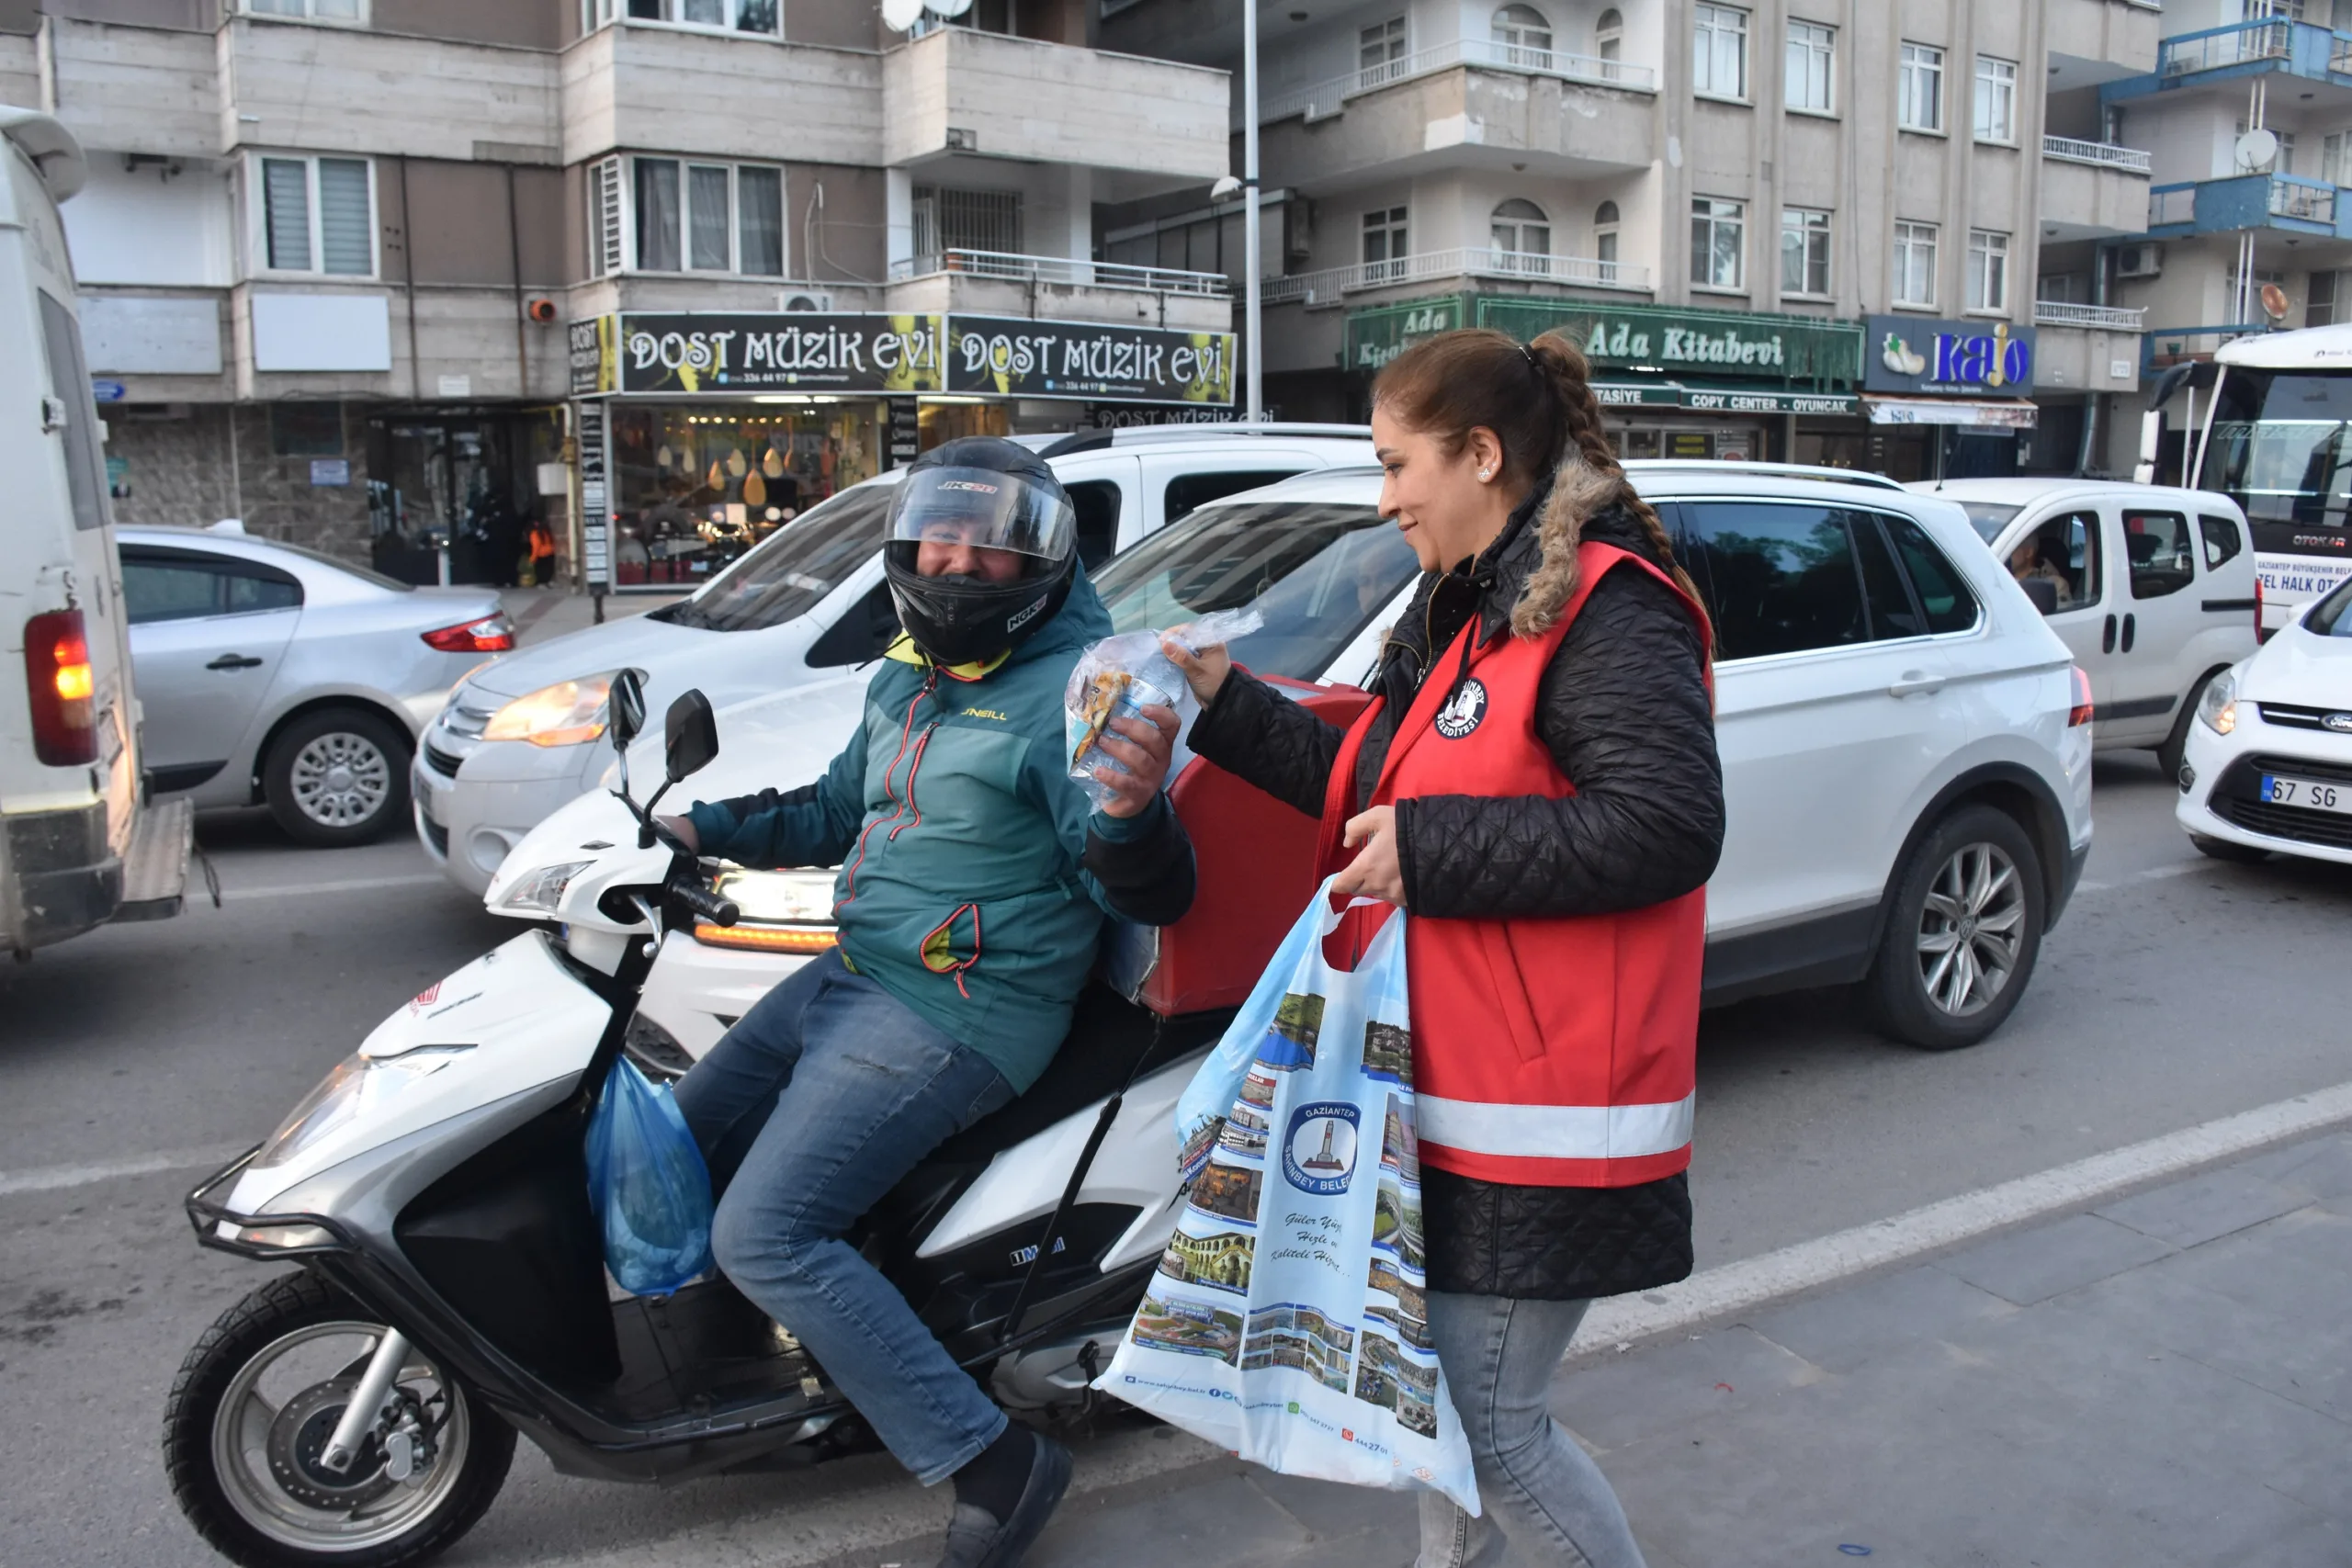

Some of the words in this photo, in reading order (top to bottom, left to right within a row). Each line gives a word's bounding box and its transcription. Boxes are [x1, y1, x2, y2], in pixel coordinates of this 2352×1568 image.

[1403, 310, 1448, 333] Ada
[629, 329, 736, 370] DOST
[743, 325, 866, 372] MÜZİK
[1585, 321, 1650, 358] Ada
[1662, 327, 1785, 366] Kitabevi
[961, 332, 1057, 375] DOST
[1062, 335, 1166, 386] MÜZİK
[1691, 394, 1725, 408] COPY
[1731, 396, 1778, 410] CENTER
[1792, 398, 1848, 412] OYUNCAK
[2292, 535, 2346, 547] OTOKAR
[2281, 575, 2313, 592] HALK
[1009, 604, 1038, 630] NGK
[2272, 781, 2297, 802] 67
[2311, 785, 2336, 807] SG
[1305, 1105, 1355, 1118] GAZİANTEP
[1284, 1213, 1317, 1227] Güler
[1296, 1231, 1328, 1246] Hızlı
[1271, 1248, 1311, 1262] Kaliteli
[1354, 1438, 1368, 1449] 444
[1368, 1442, 1380, 1452] 27
[1380, 1446, 1388, 1455] 01
